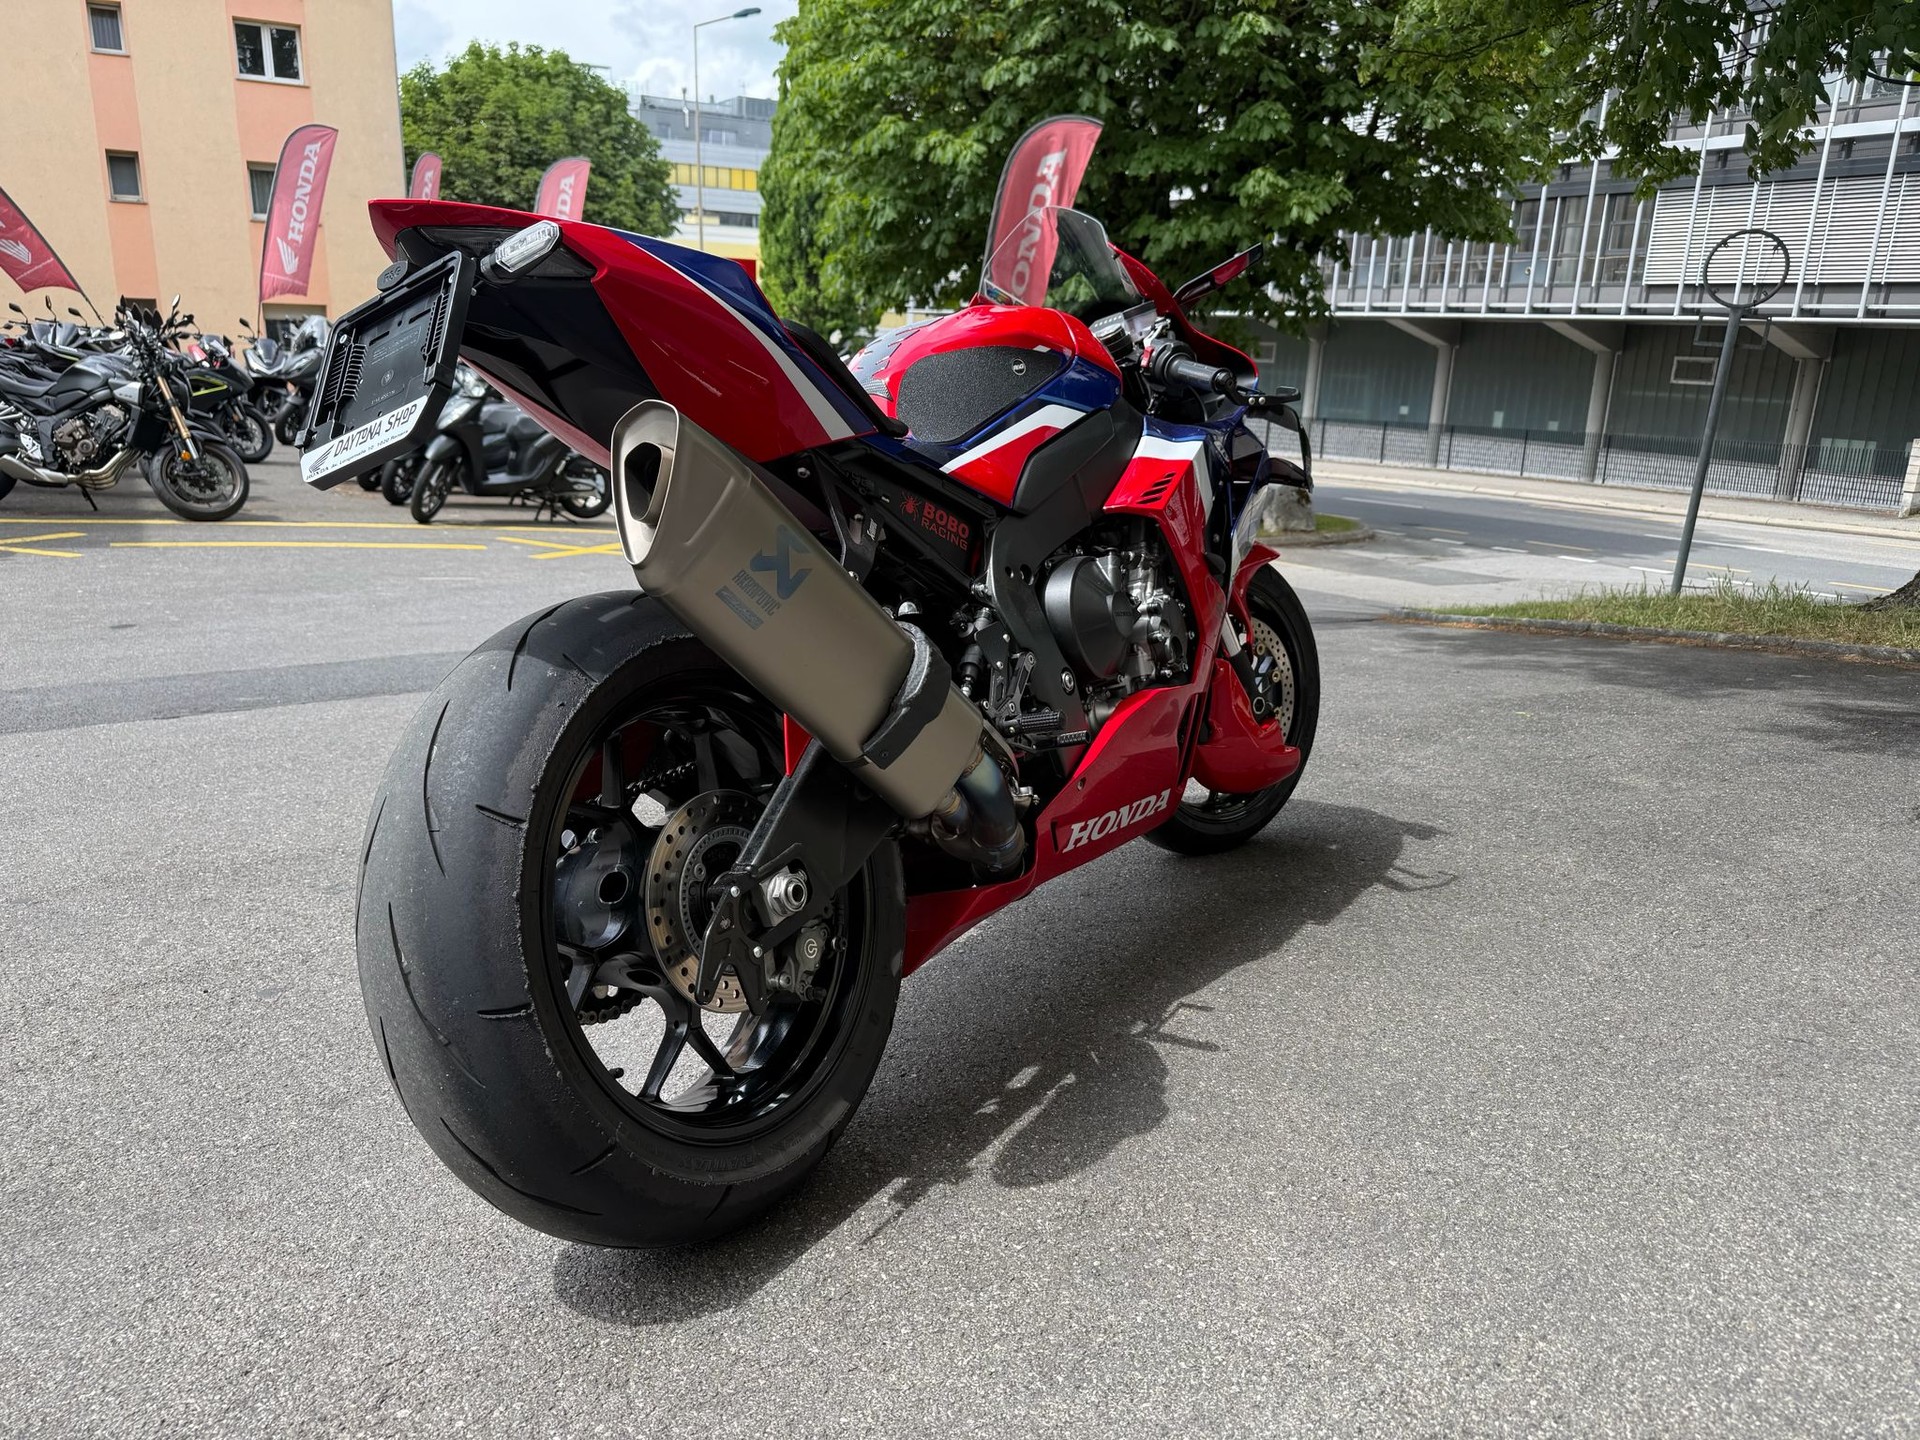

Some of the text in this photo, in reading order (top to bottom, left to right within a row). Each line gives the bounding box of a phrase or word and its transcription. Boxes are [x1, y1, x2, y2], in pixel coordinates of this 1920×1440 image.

[288, 141, 321, 244] HONDA
[1011, 148, 1067, 298] ONDA
[334, 403, 417, 457] DAYTONA SHOP
[921, 519, 968, 551] RACING
[923, 501, 970, 539] BOBO
[1062, 788, 1171, 854] HONDA
